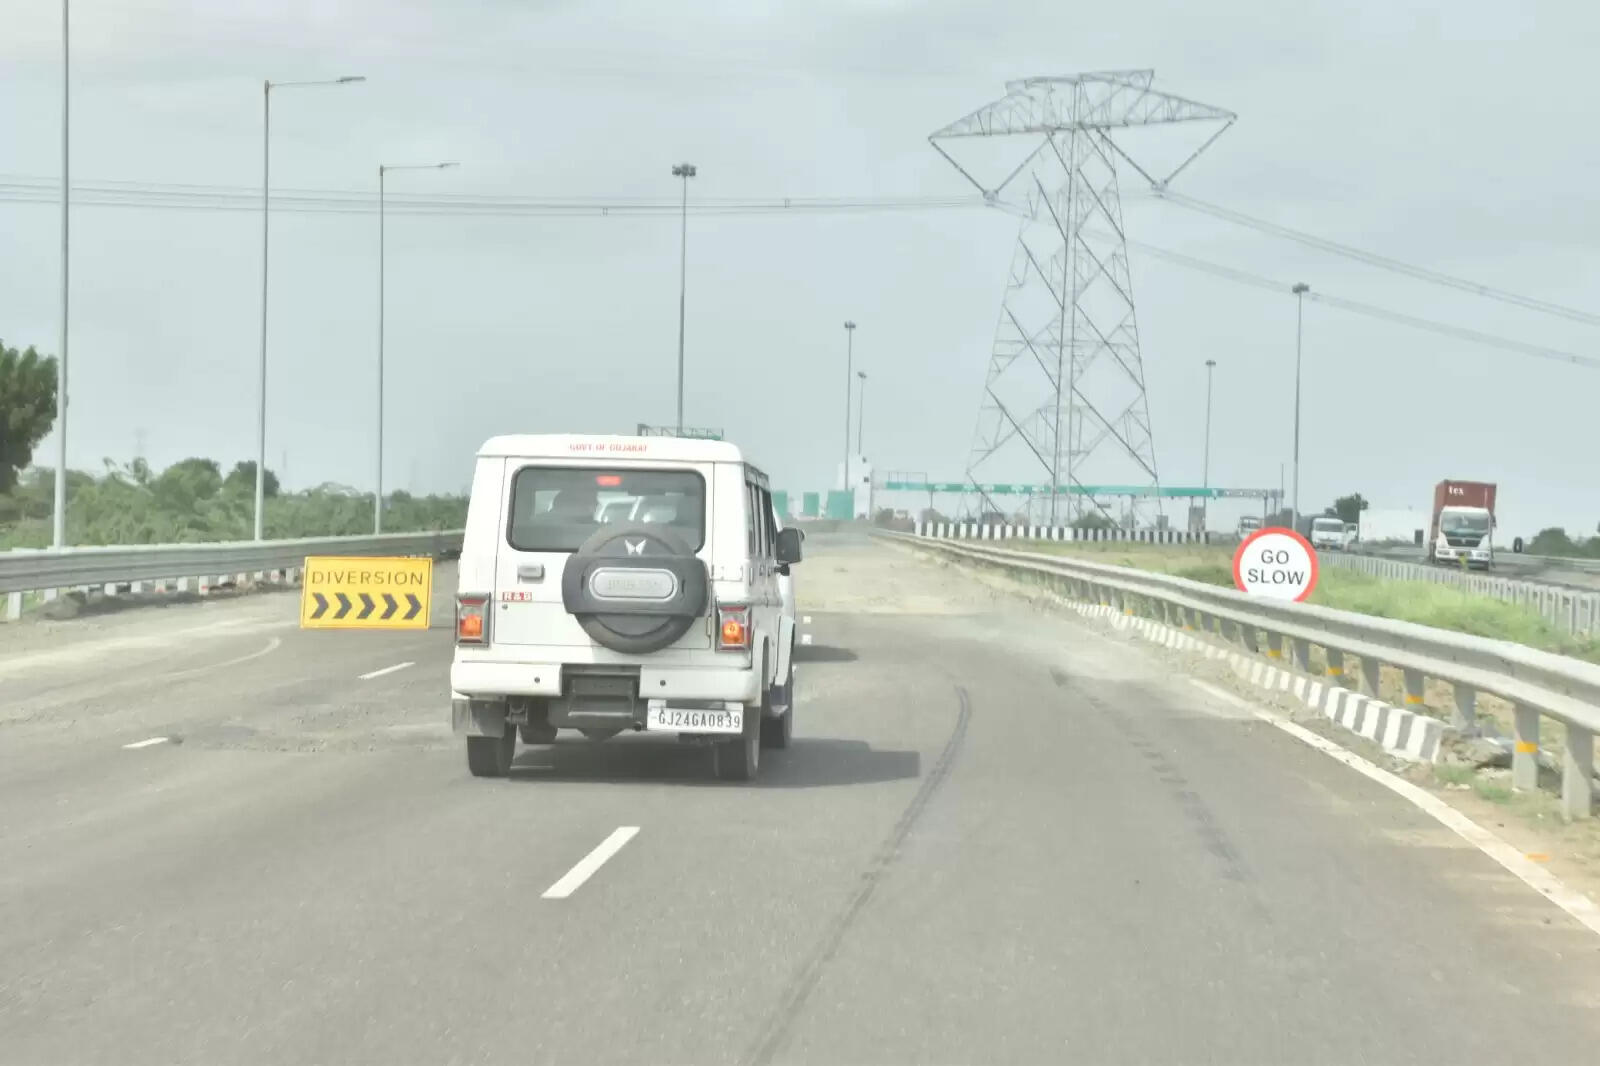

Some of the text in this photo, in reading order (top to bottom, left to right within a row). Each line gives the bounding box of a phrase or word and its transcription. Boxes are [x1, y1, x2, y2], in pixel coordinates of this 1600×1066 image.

[609, 443, 647, 453] GUJARAT
[1448, 485, 1464, 496] tex
[1260, 549, 1290, 565] GO
[311, 570, 424, 586] DIVERSION
[1247, 568, 1305, 586] SLOW
[658, 711, 741, 729] GJ24GA0839
